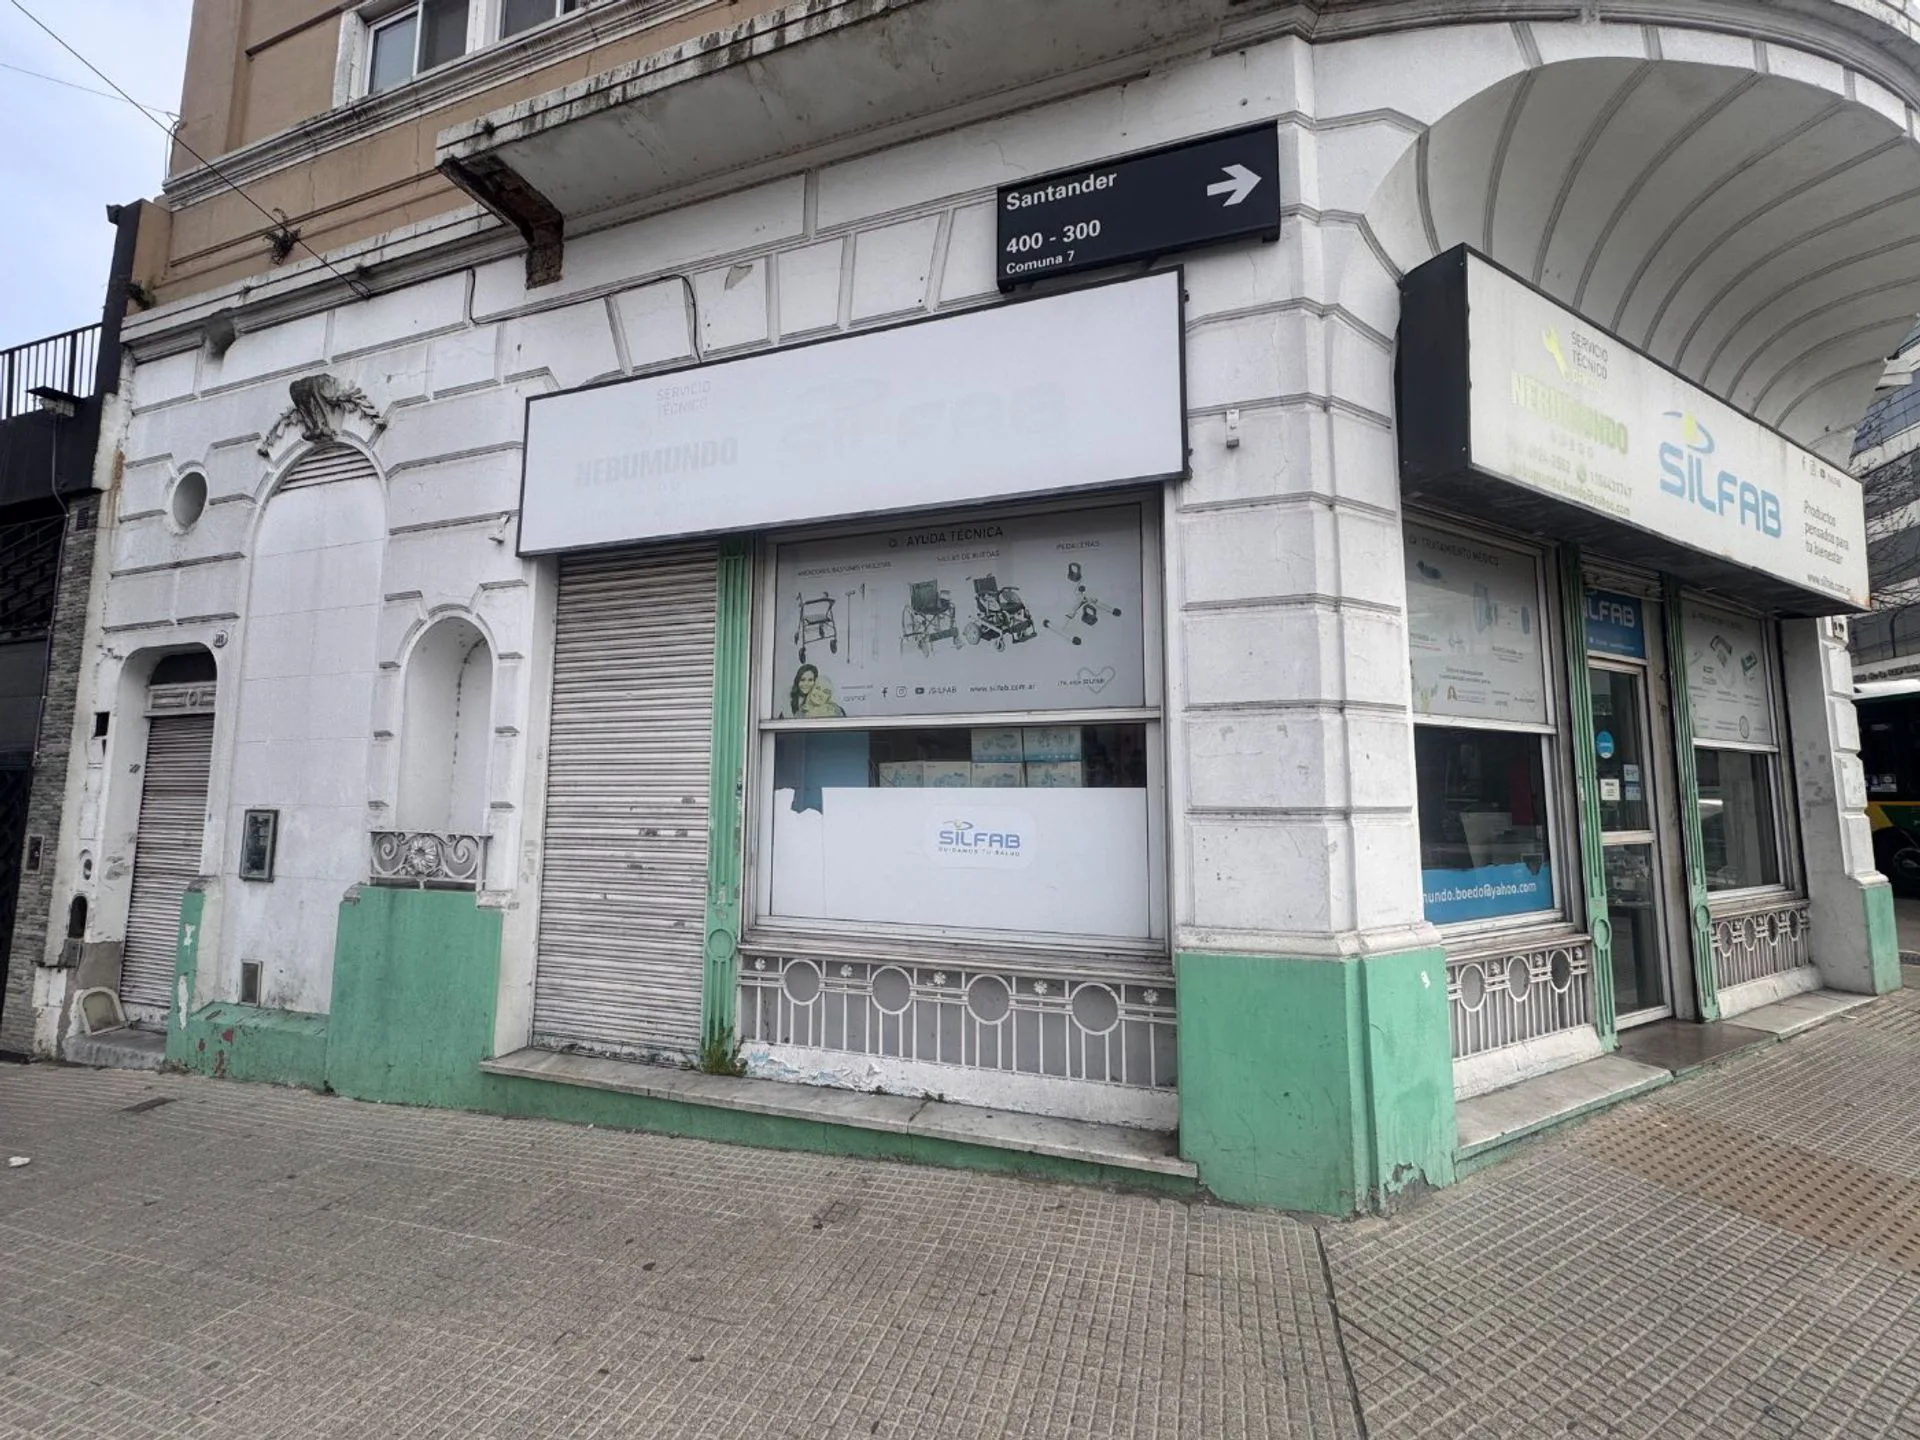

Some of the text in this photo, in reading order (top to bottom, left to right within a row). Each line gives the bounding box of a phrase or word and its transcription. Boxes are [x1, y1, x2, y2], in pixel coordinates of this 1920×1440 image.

[1006, 171, 1117, 211] Santander
[1006, 232, 1043, 254] 400
[1062, 219, 1101, 243] 300
[1006, 250, 1075, 274] Comuna 7
[1571, 331, 1608, 364] SERVICIO
[656, 380, 711, 401] SERVICIO
[1659, 441, 1782, 539] SILFAB
[906, 532, 947, 547] AYUDA
[938, 830, 1021, 849] SILFAB
